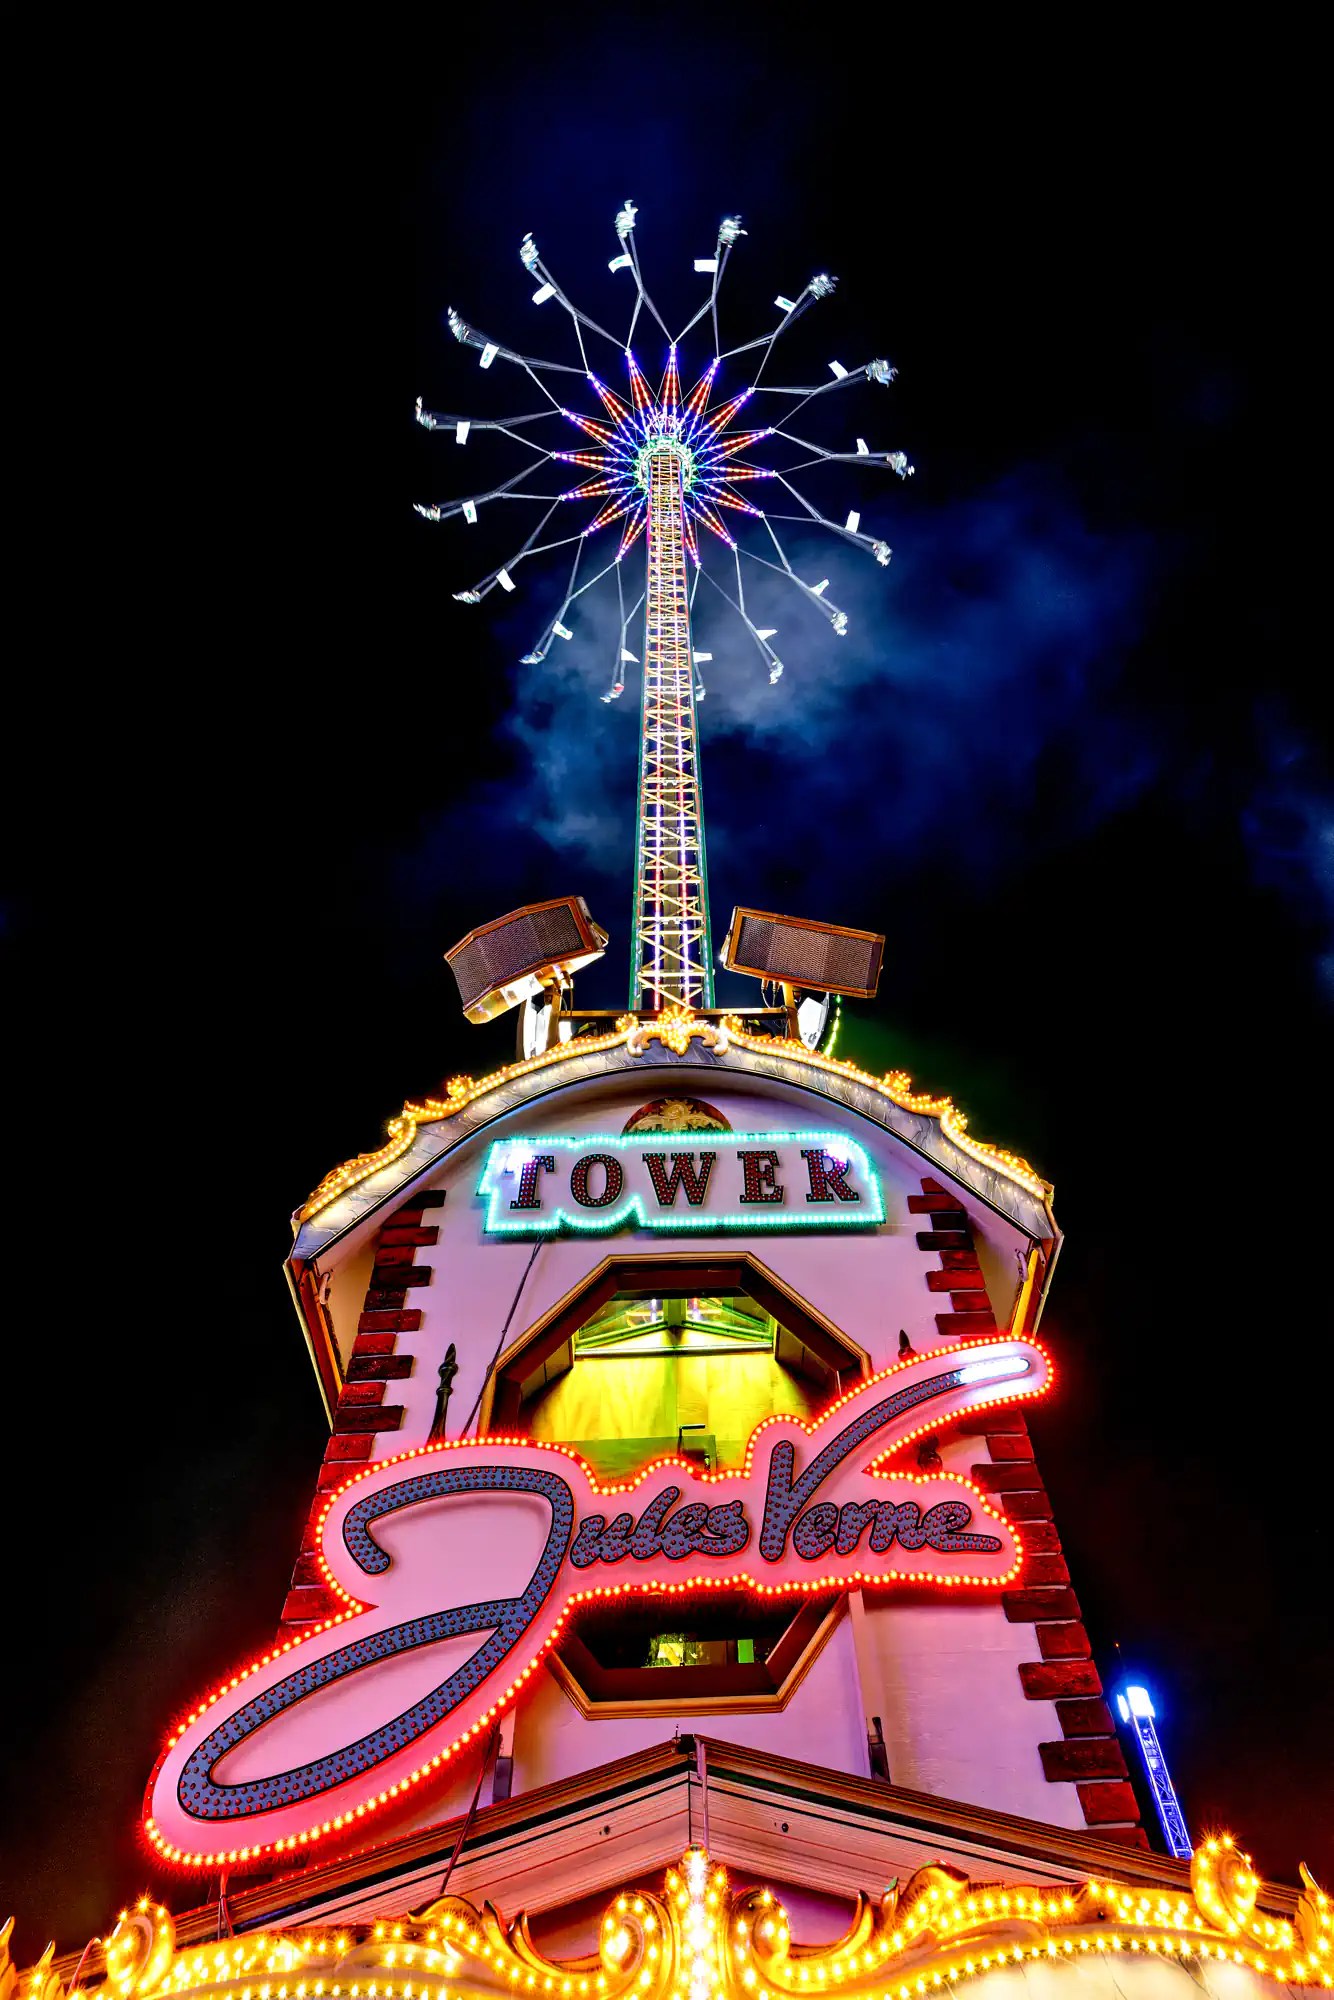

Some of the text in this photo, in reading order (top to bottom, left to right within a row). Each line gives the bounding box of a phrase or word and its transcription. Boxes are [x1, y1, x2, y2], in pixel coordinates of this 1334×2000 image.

[504, 1149, 860, 1209] TOWER
[177, 1357, 1030, 1820] Jules Verne
